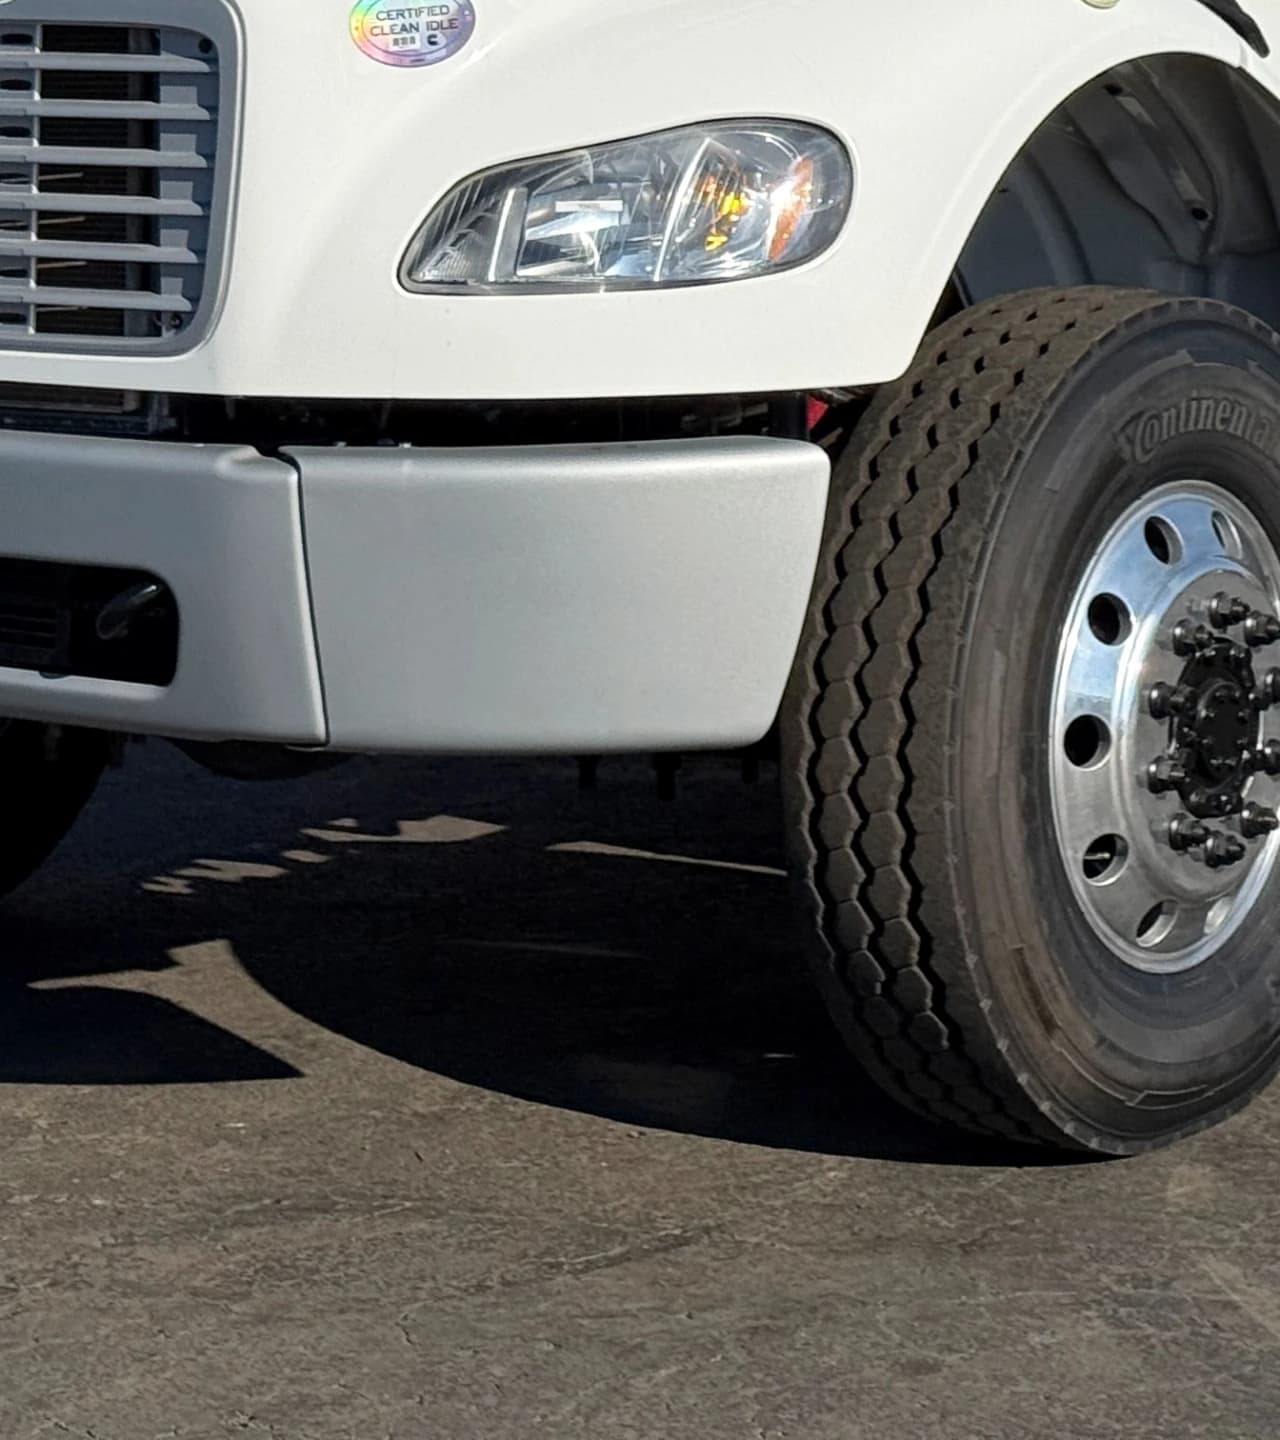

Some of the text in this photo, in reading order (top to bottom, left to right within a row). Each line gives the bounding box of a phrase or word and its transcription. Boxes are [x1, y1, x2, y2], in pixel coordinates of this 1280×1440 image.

[376, 5, 450, 21] CERTIFIED
[370, 18, 459, 37] CLEAN IDLE
